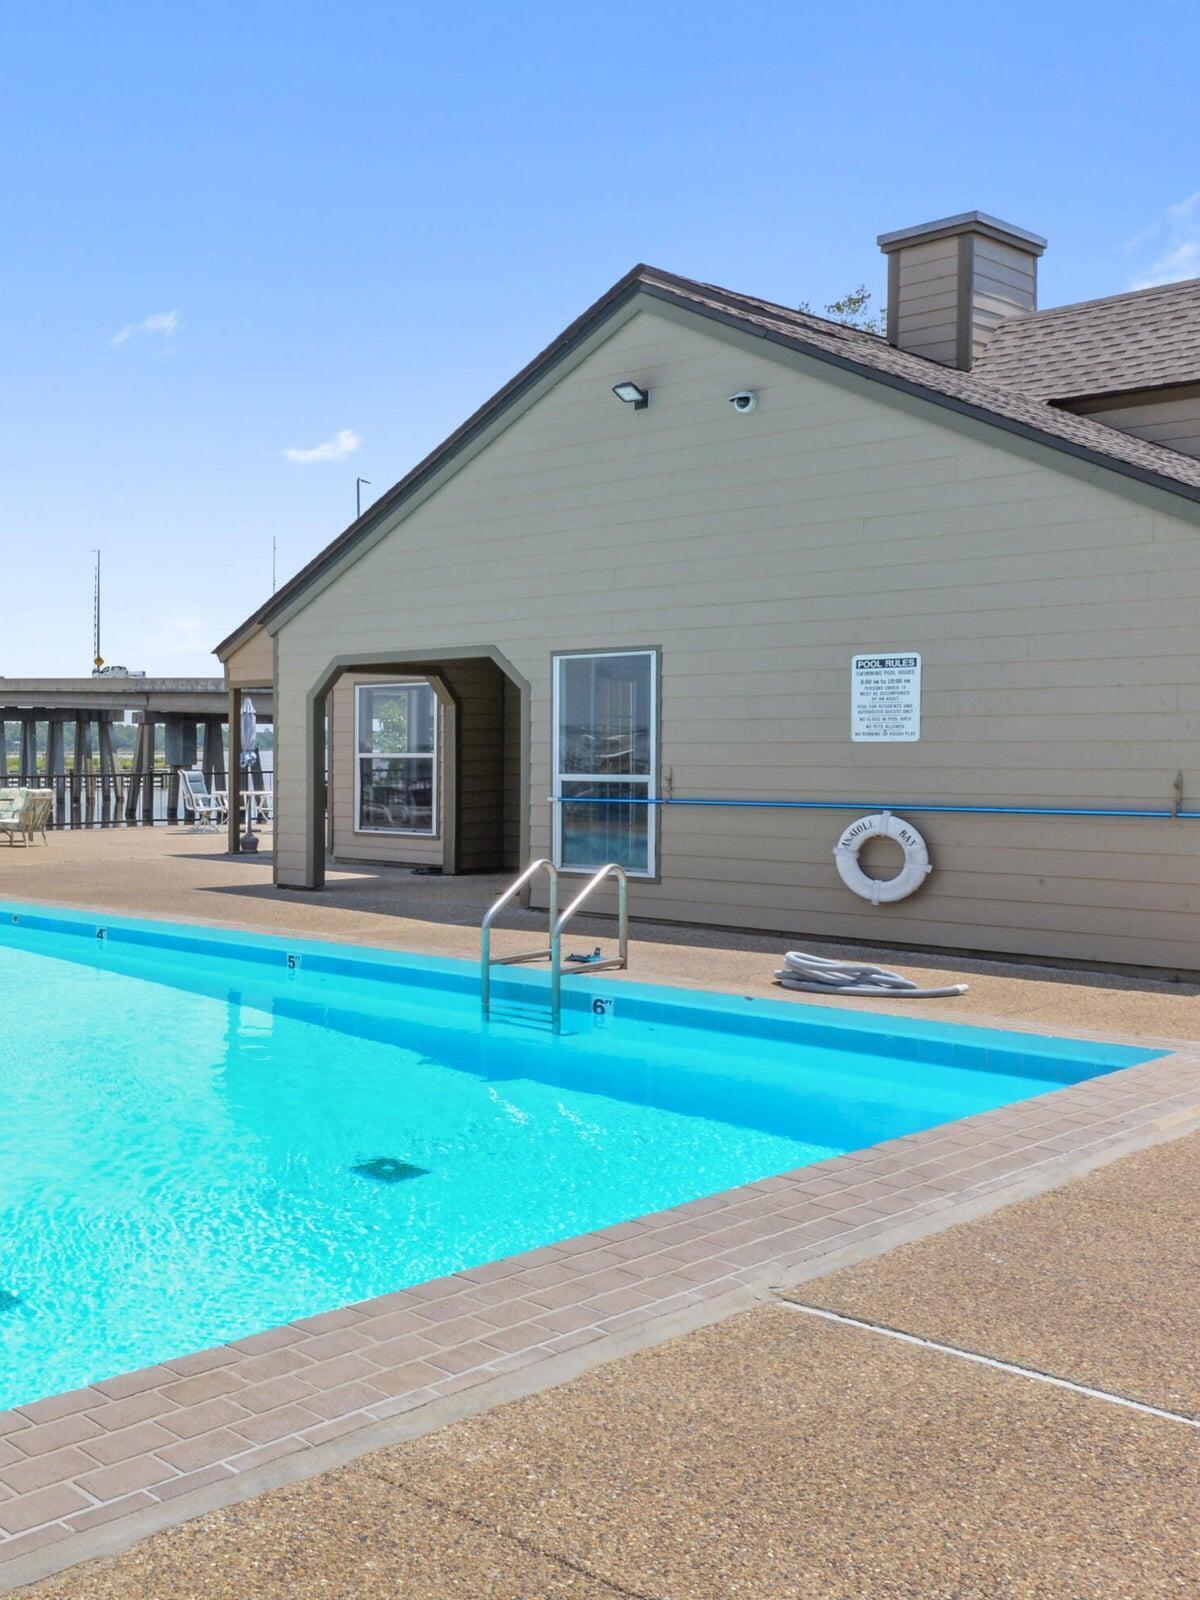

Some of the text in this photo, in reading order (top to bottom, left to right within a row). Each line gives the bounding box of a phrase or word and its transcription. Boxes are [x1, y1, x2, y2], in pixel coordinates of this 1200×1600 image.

[858, 659, 915, 668] POOL RULES
[841, 820, 918, 849] ANATOLE BAY
